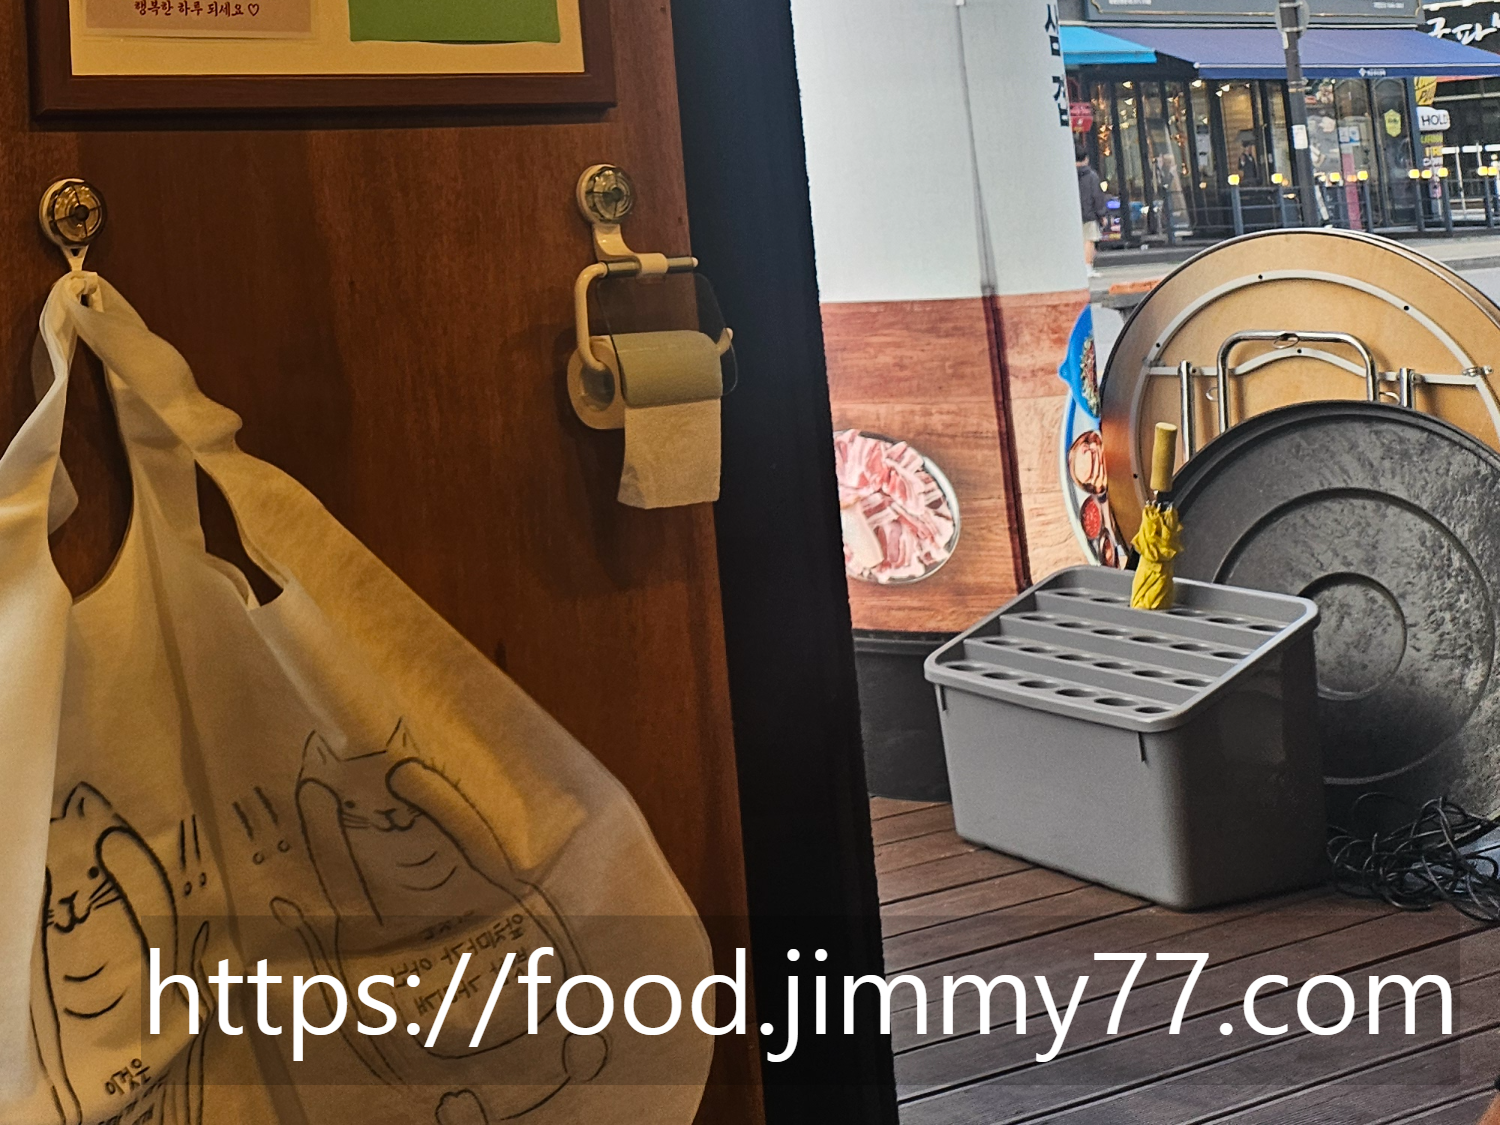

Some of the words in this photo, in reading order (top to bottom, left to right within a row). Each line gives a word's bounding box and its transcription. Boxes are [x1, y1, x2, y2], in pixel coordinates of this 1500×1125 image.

[134, 0, 173, 16] 행복한
[178, 0, 203, 16] 하루
[207, 1, 244, 17] 되세요
